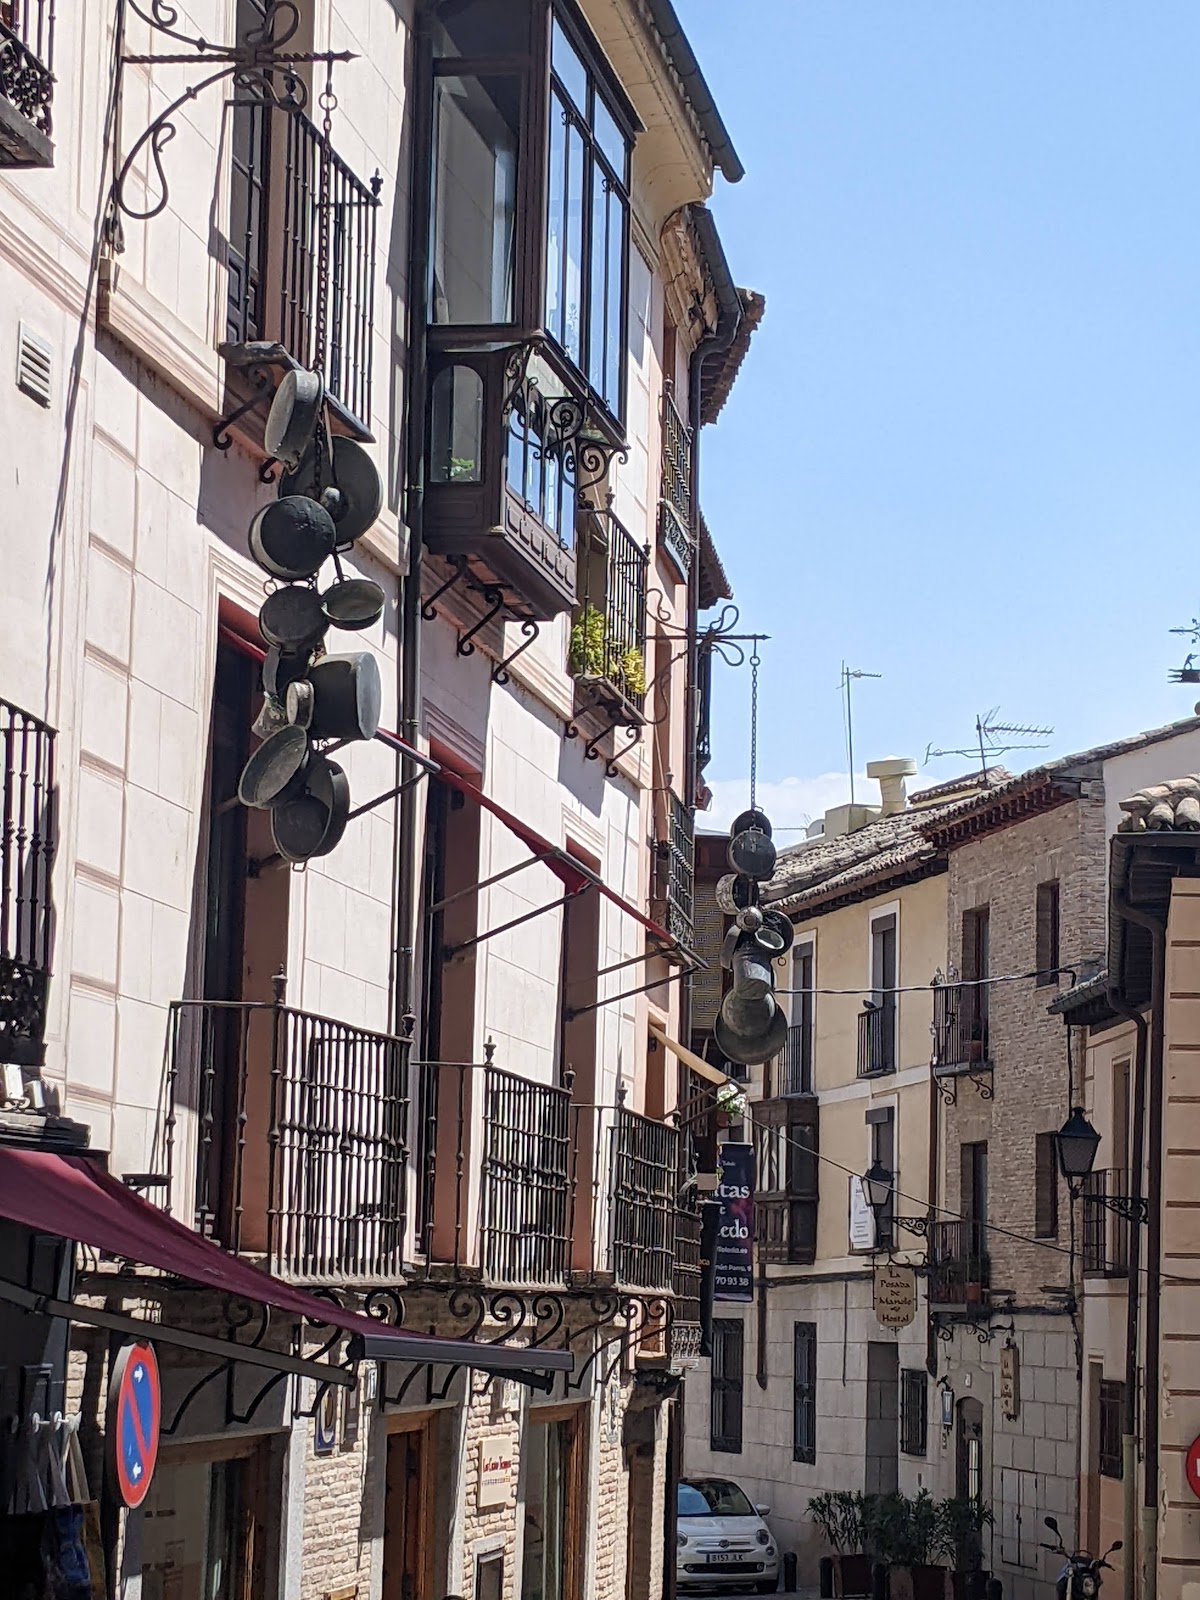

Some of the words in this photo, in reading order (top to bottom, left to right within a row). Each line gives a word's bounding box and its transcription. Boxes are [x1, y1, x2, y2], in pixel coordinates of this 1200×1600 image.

[717, 1219, 749, 1239] edo
[716, 1277, 727, 1286] 70
[727, 1278, 738, 1286] 93
[739, 1278, 749, 1287] 38
[882, 1314, 909, 1322] Hostal
